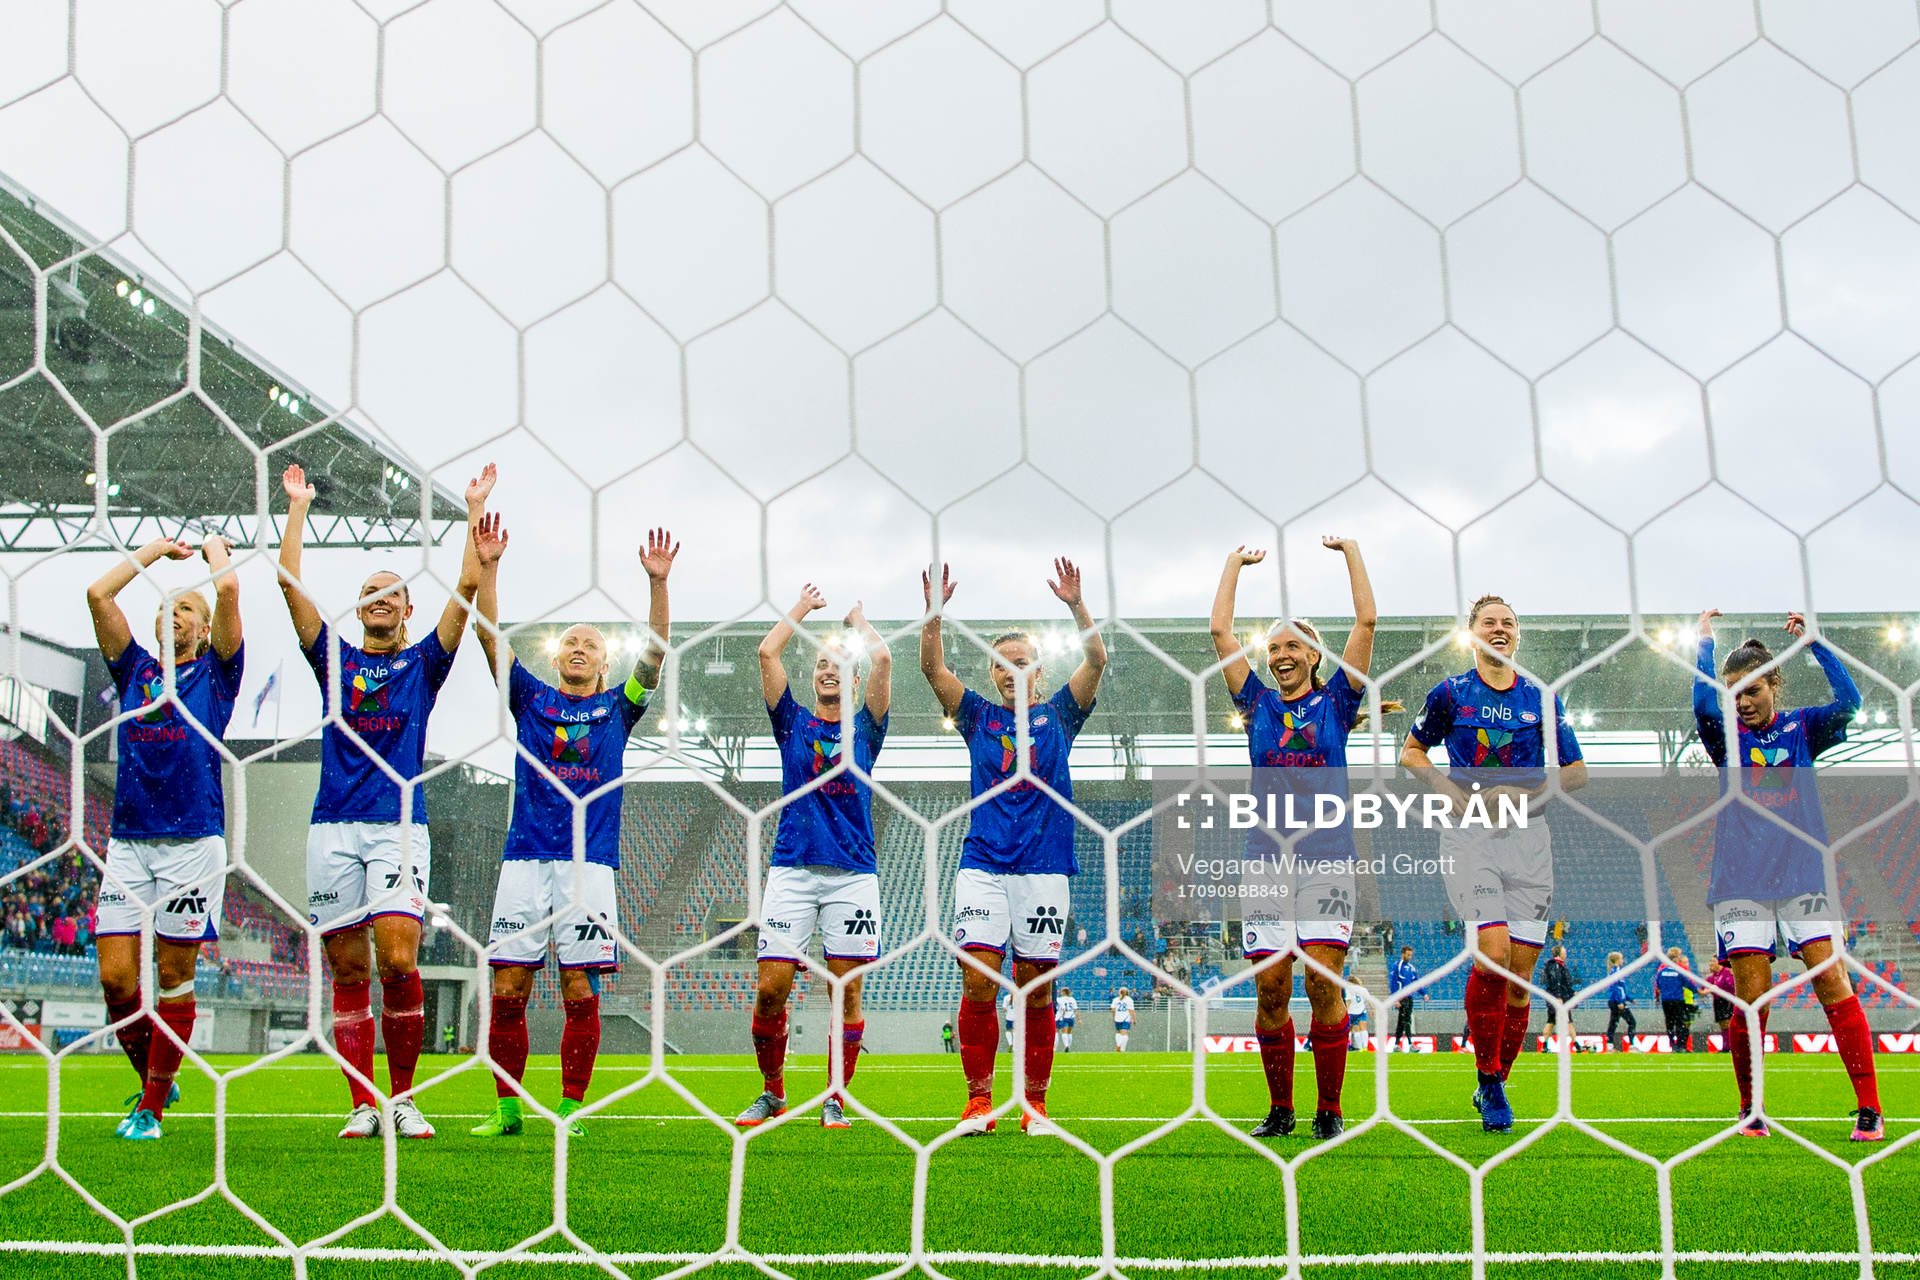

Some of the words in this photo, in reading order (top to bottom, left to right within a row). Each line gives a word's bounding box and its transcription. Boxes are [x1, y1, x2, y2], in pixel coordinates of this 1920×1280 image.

[560, 709, 590, 722] DNB
[1482, 703, 1512, 723] DNB
[342, 716, 401, 732] ABONA
[127, 726, 187, 742] SABONA
[1266, 750, 1327, 768] SABONA
[538, 764, 601, 782] ABONA
[1744, 787, 1798, 807] ABONA
[1204, 1036, 1260, 1053] VG
[1794, 1035, 1838, 1053] V
[1879, 1035, 1920, 1053] V
